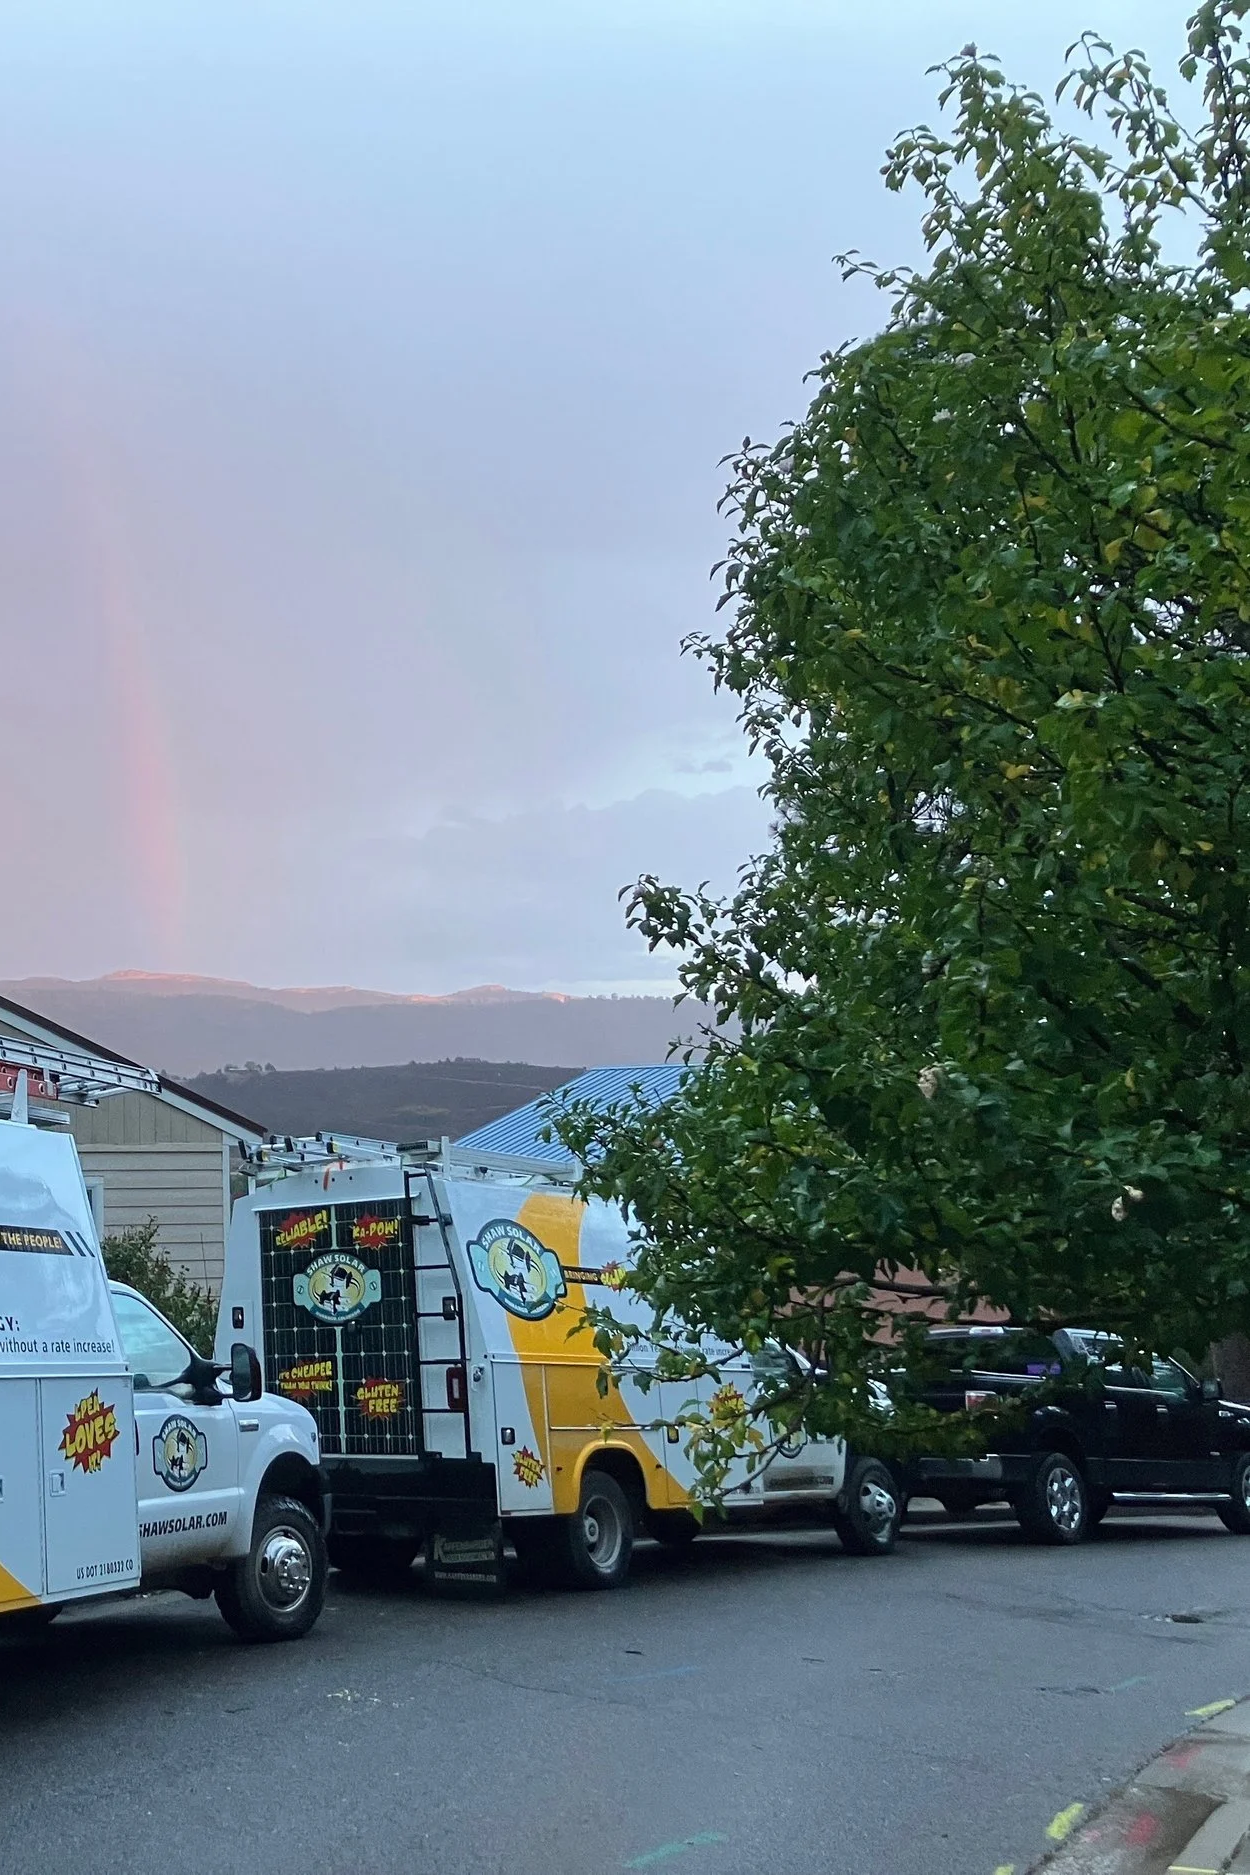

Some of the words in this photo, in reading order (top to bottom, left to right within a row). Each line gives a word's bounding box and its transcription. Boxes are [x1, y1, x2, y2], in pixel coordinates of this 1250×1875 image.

[275, 1210, 328, 1246] RELIABLE!
[352, 1219, 399, 1239] KA-POW!
[1, 1231, 23, 1246] THE
[24, 1233, 63, 1249] PEOPLE!
[482, 1225, 506, 1249] SHAW
[506, 1226, 542, 1256] SOLAR
[306, 1254, 332, 1276] SHAW
[334, 1254, 365, 1273] SOLAR
[42, 1341, 49, 1353] a
[50, 1339, 71, 1353] rate
[73, 1338, 115, 1354] increase!
[291, 1360, 332, 1380] CHEAPER
[357, 1384, 399, 1400] GLUTEN
[368, 1399, 398, 1413] FREE
[65, 1411, 116, 1457] LOVES
[76, 1566, 85, 1580] US
[86, 1564, 98, 1578] DOT
[125, 1559, 134, 1571] CO
